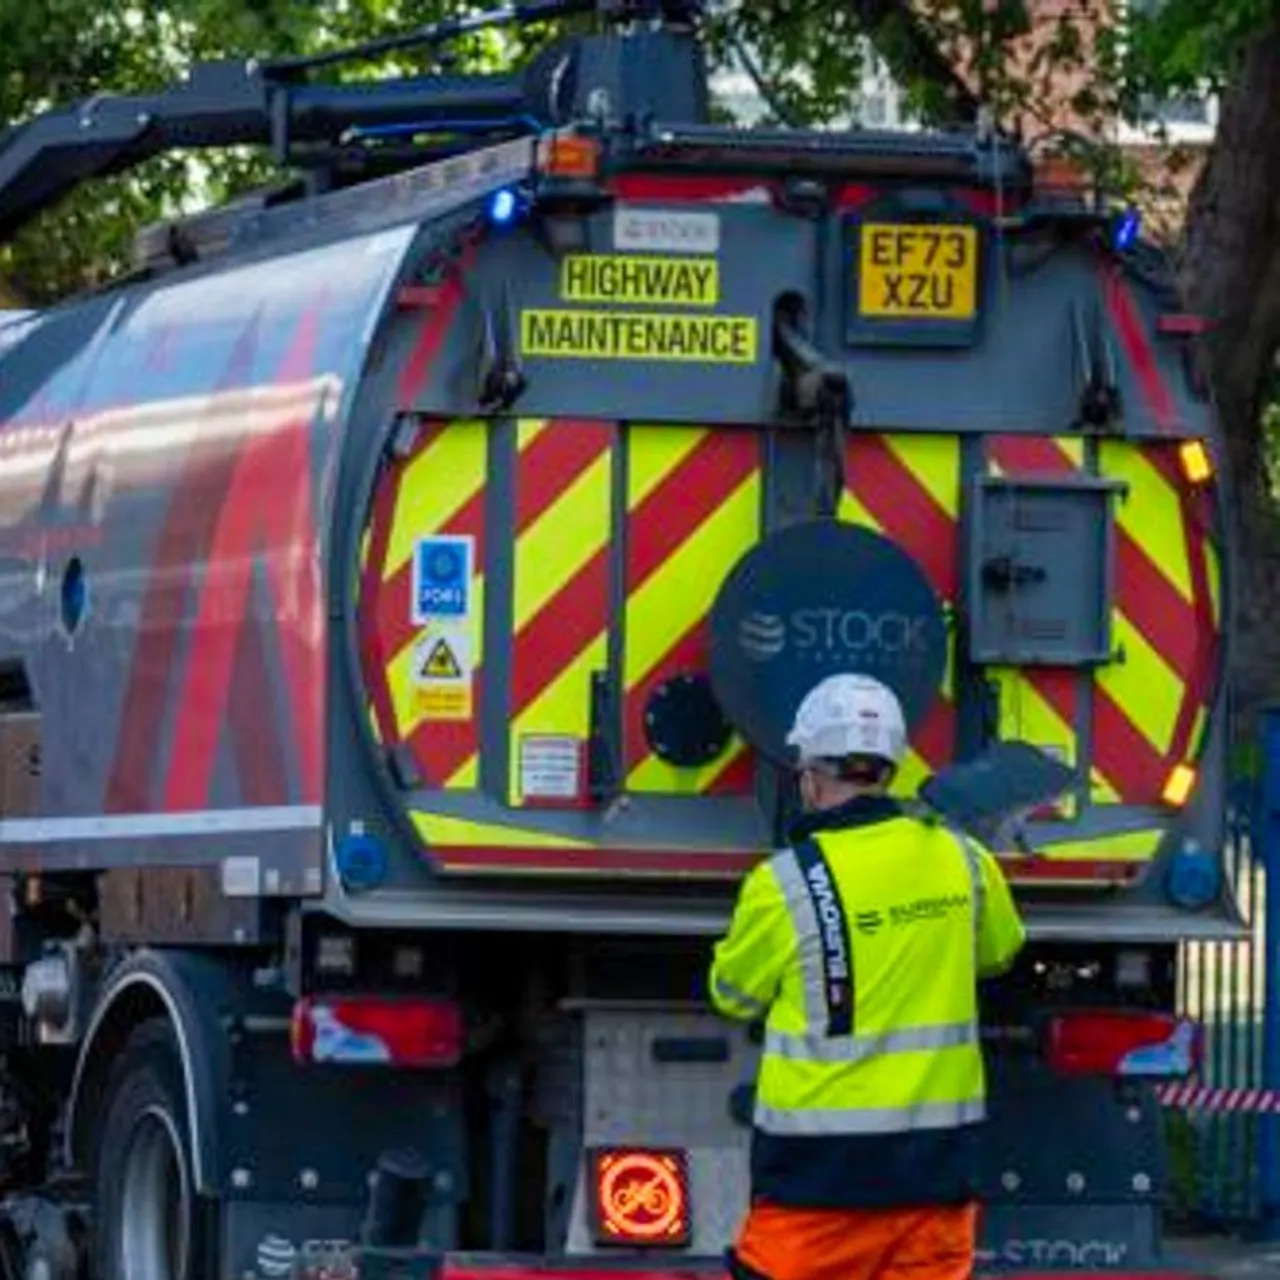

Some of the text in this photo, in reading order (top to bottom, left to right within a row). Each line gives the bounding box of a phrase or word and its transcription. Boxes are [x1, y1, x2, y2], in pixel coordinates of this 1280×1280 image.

[871, 231, 967, 269] EF73
[567, 259, 712, 299] HIGHWAY
[882, 273, 954, 310] XZU
[529, 314, 749, 357] MAINTENANCE
[791, 607, 927, 651] STOCK
